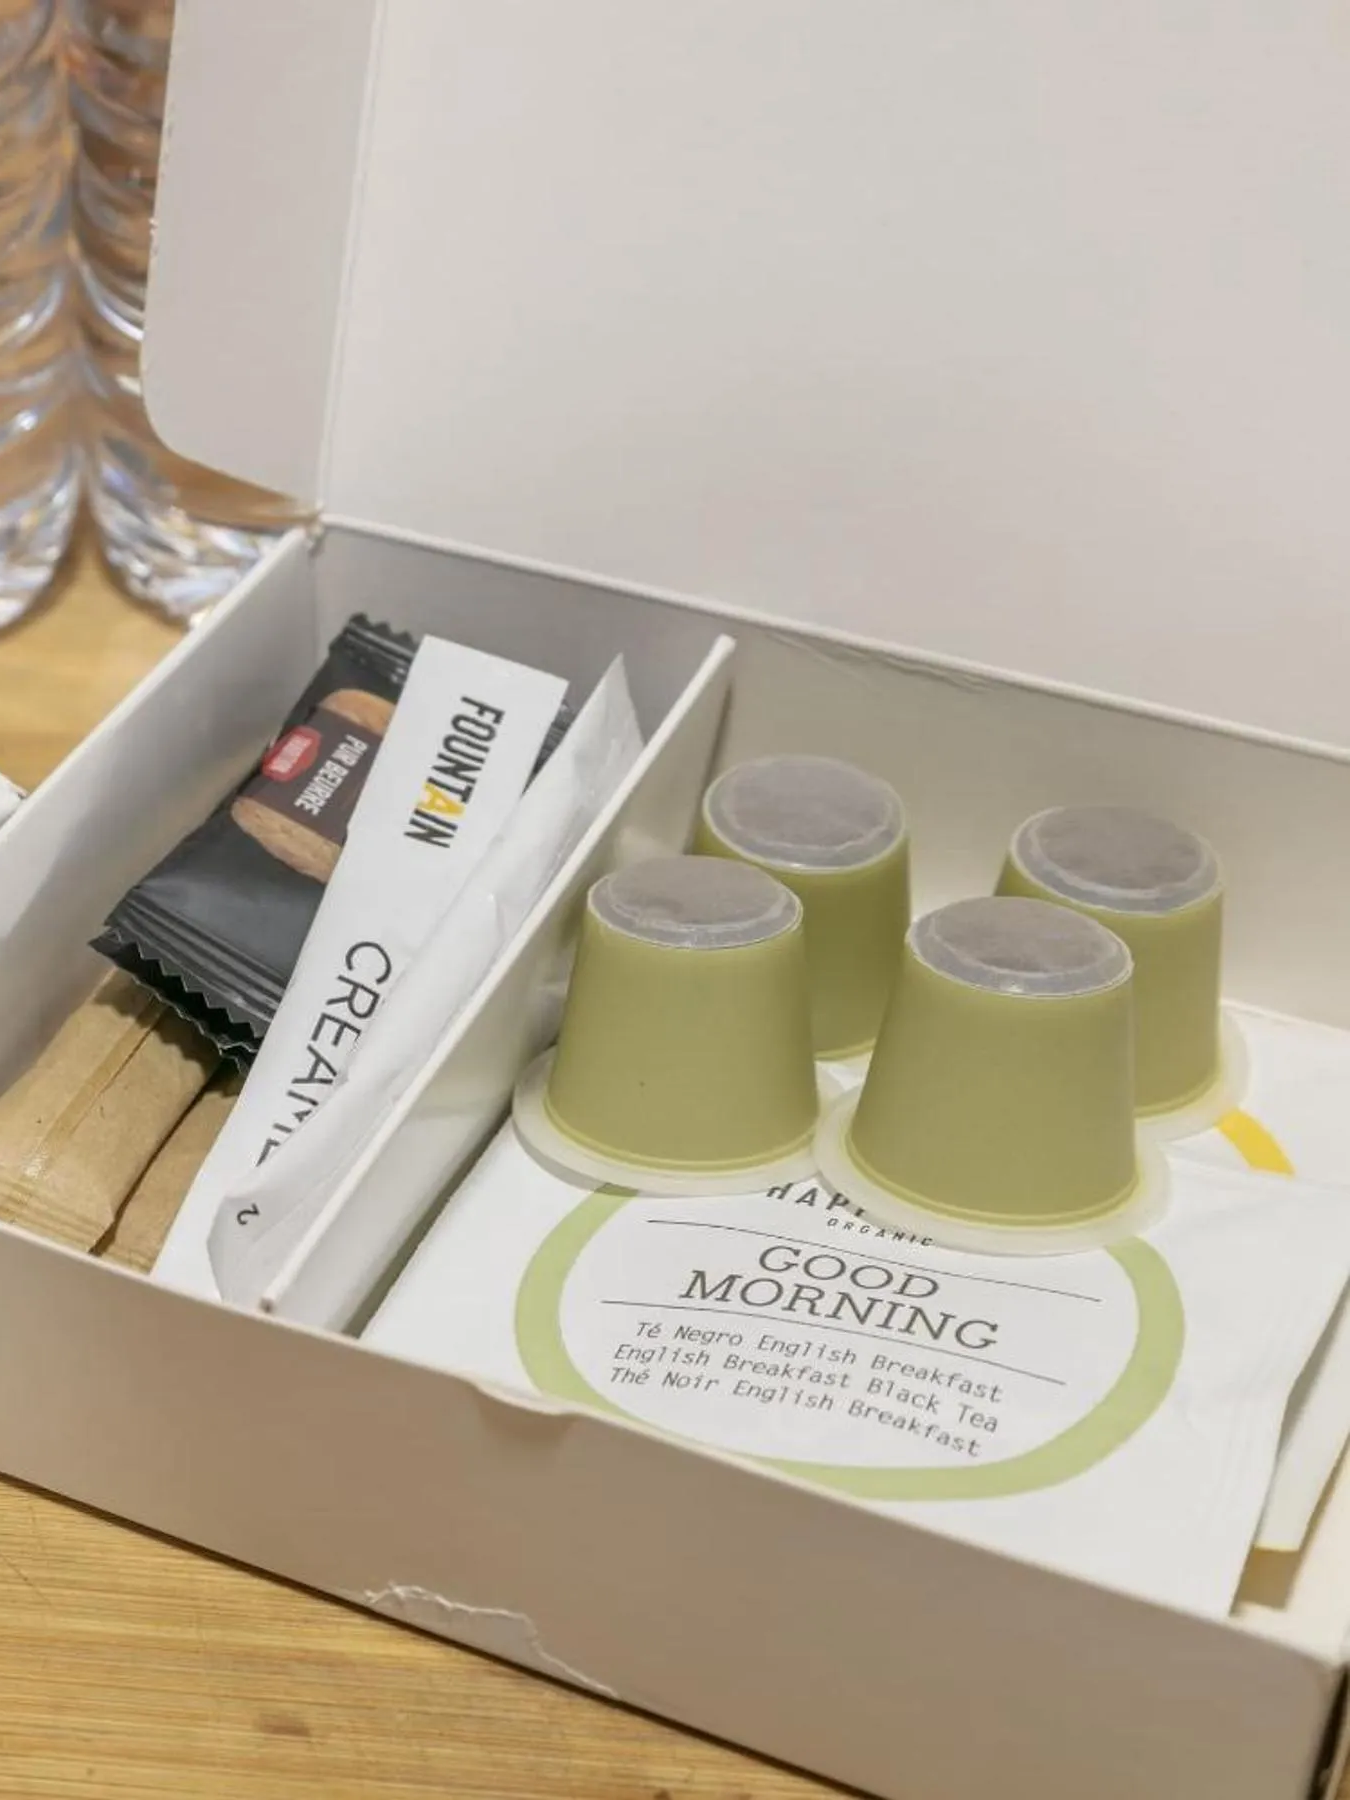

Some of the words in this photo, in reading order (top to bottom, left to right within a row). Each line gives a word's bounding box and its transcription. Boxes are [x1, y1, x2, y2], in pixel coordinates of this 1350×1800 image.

[293, 760, 349, 815] BEURRE
[331, 734, 368, 767] PUR
[403, 696, 506, 849] FOUNTAIN
[758, 1245, 939, 1299] GOOD
[827, 1217, 934, 1247] ORGANIC
[678, 1270, 999, 1350] MORNING
[613, 1343, 710, 1367] English
[723, 1353, 852, 1390] Breakfast
[866, 1376, 941, 1416] Black
[957, 1402, 999, 1434] Tea
[636, 1321, 663, 1339] Té
[674, 1325, 744, 1347] Negro
[757, 1334, 858, 1366] English
[870, 1354, 1004, 1404] Breakfast
[610, 1366, 651, 1386] Thé
[662, 1370, 720, 1392] Noir
[732, 1379, 834, 1412] English
[848, 1399, 983, 1458] Breakfast
